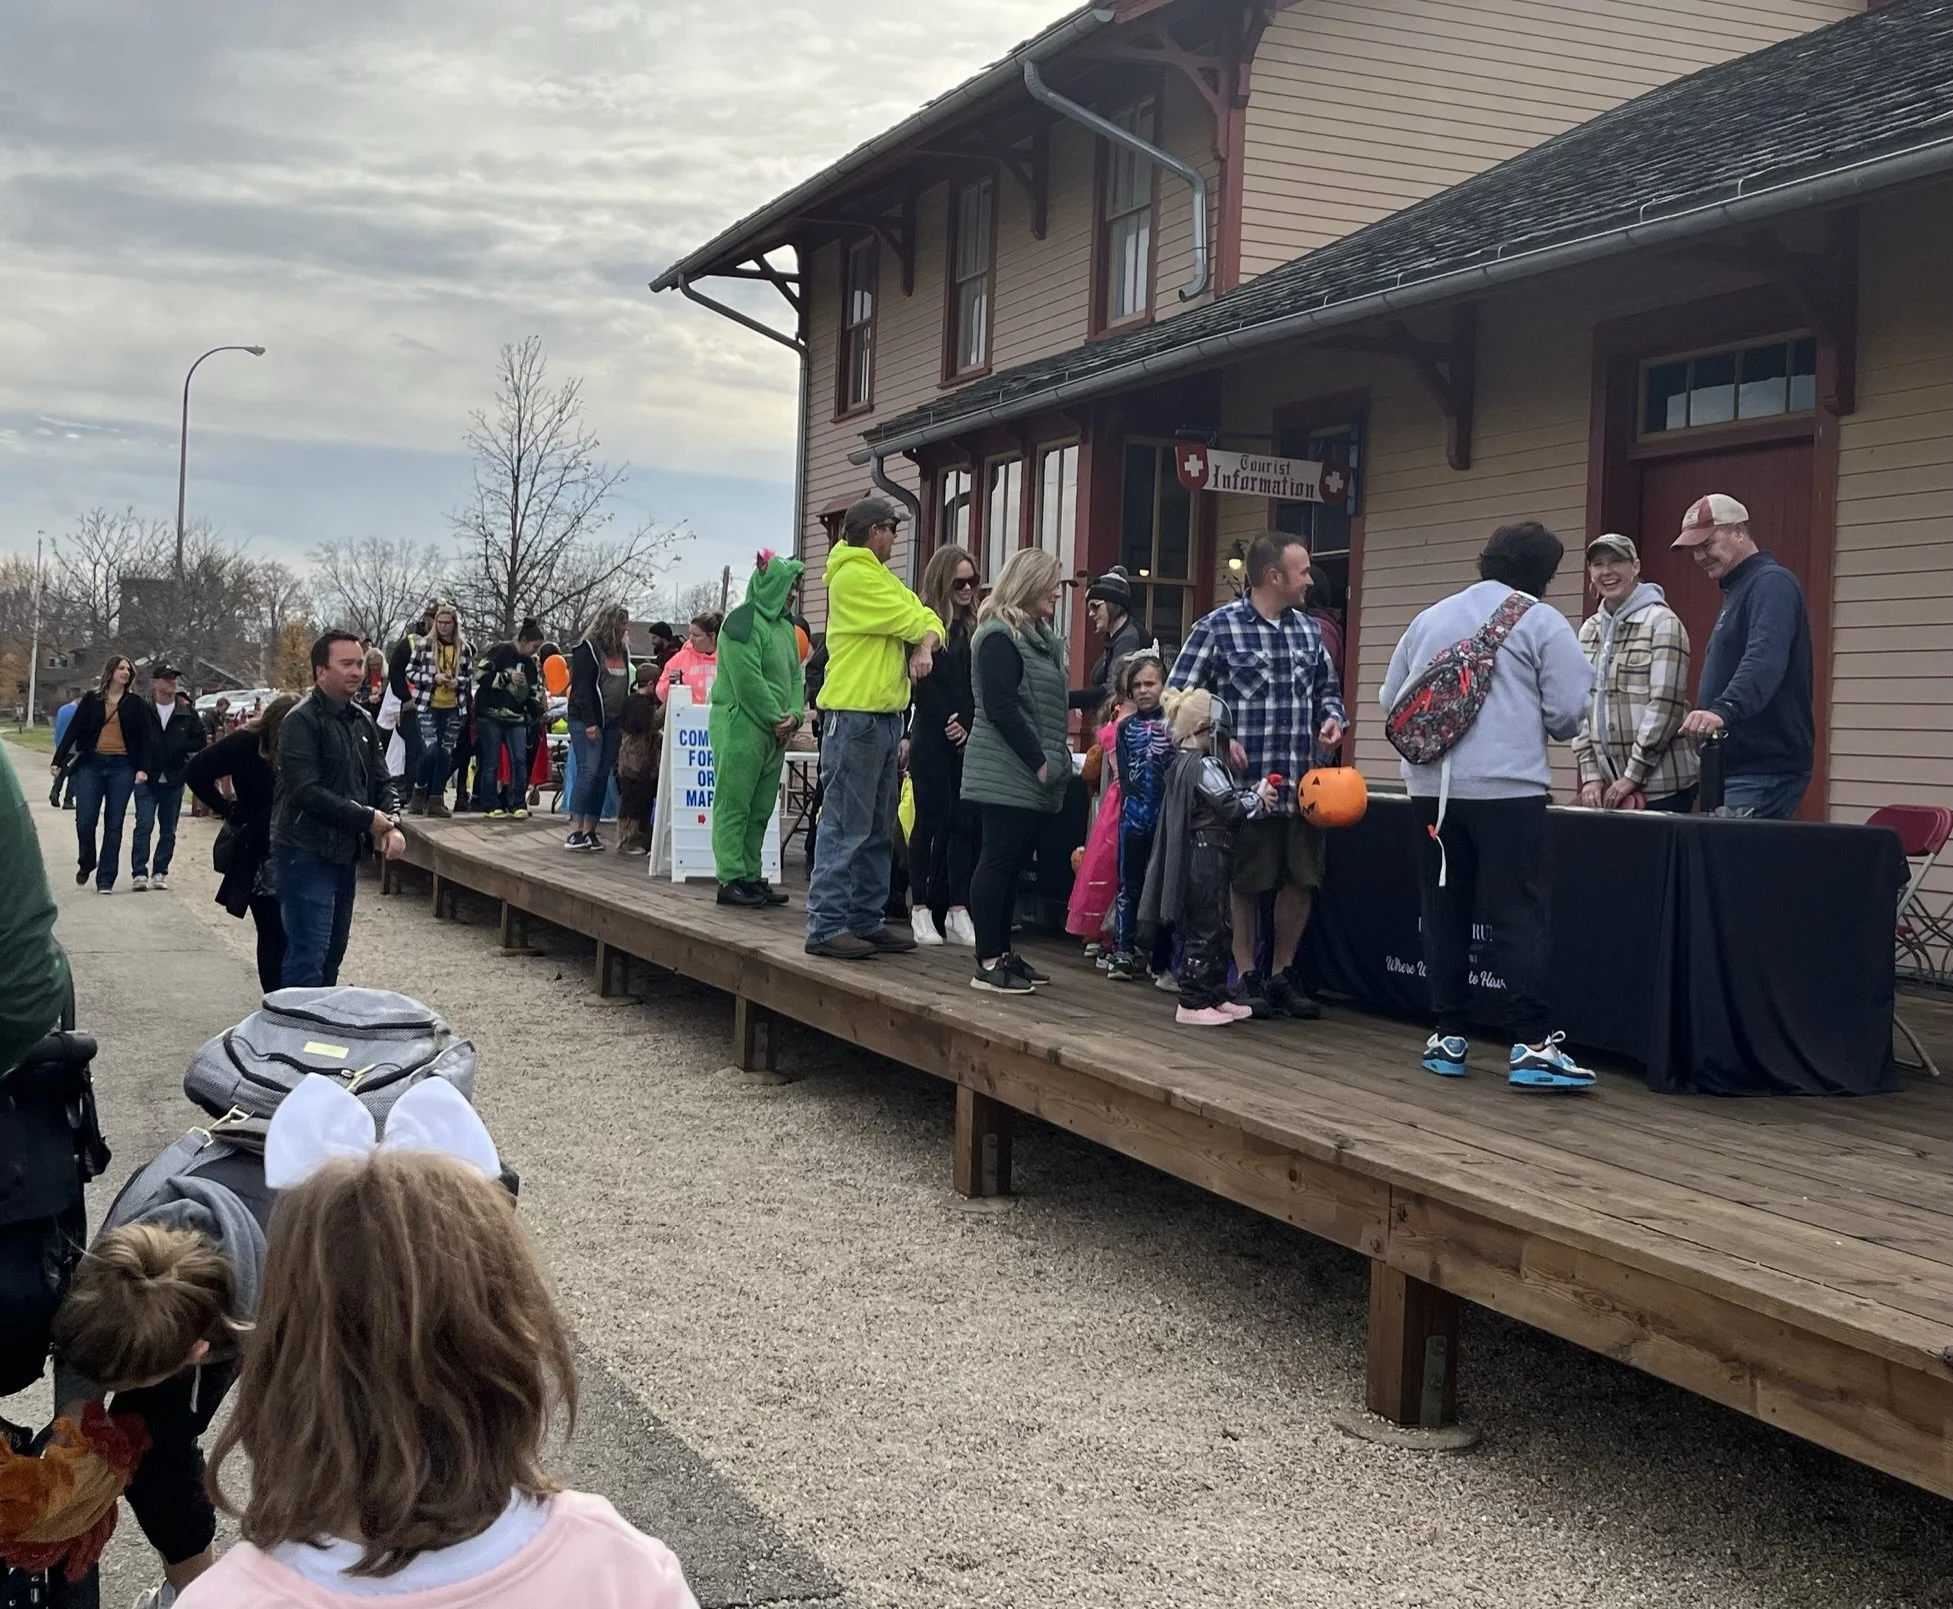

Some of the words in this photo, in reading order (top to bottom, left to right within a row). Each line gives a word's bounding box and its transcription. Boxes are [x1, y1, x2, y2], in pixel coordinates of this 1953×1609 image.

[1240, 454, 1291, 476] Tourist
[1213, 464, 1315, 498] Information
[679, 729, 709, 747] COM
[688, 749, 714, 767] FOR
[697, 769, 715, 787] OR
[1385, 955, 1415, 975] Where
[1468, 970, 1479, 985] to
